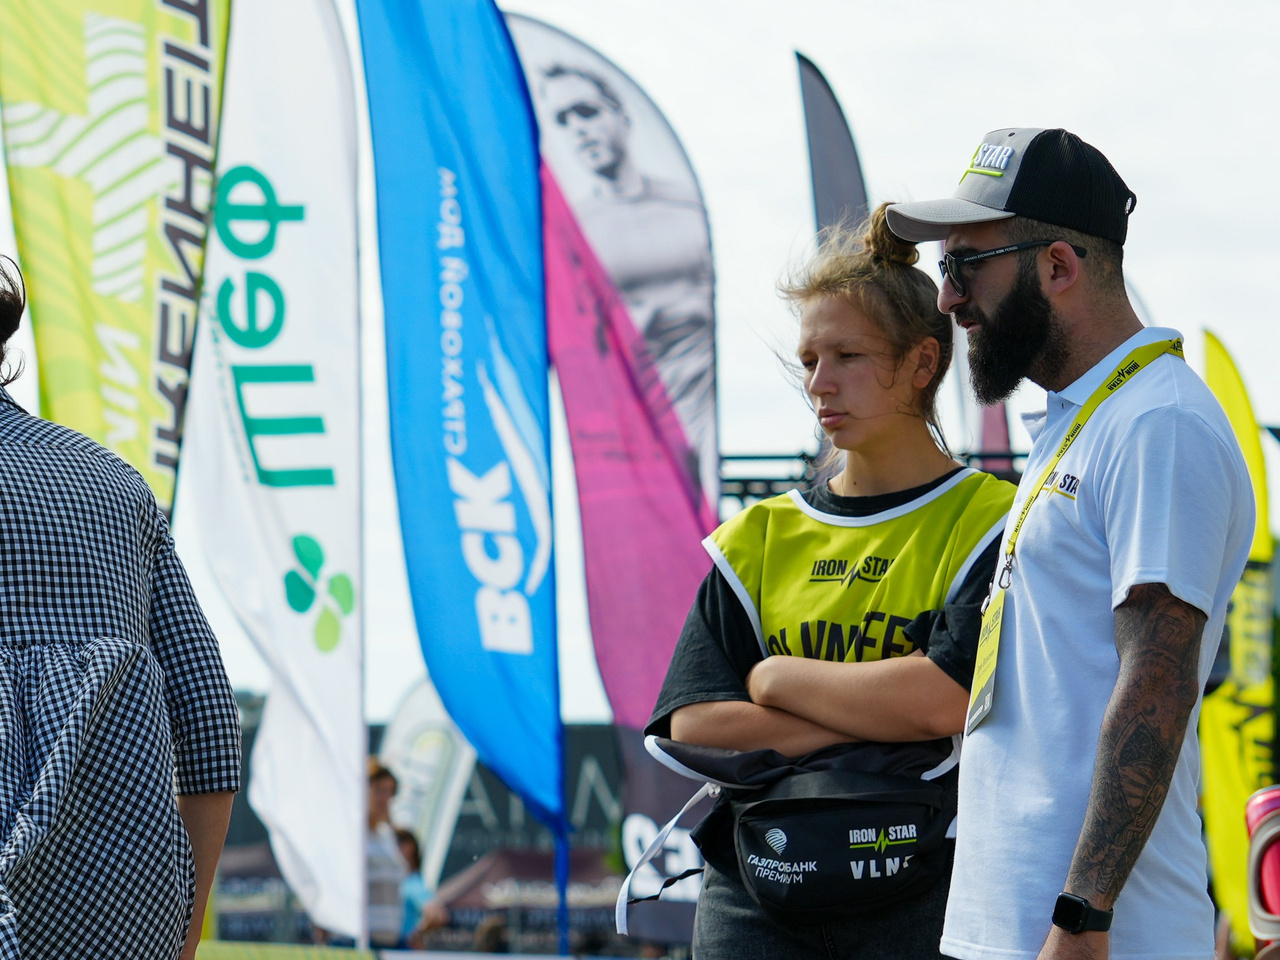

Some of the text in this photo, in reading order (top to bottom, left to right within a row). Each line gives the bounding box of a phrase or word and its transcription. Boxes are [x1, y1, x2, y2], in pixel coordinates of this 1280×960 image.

[974, 142, 1015, 170] STAR
[1107, 361, 1140, 391] IRON STAR
[811, 560, 848, 576] IRON
[849, 824, 917, 843] IRON STAR
